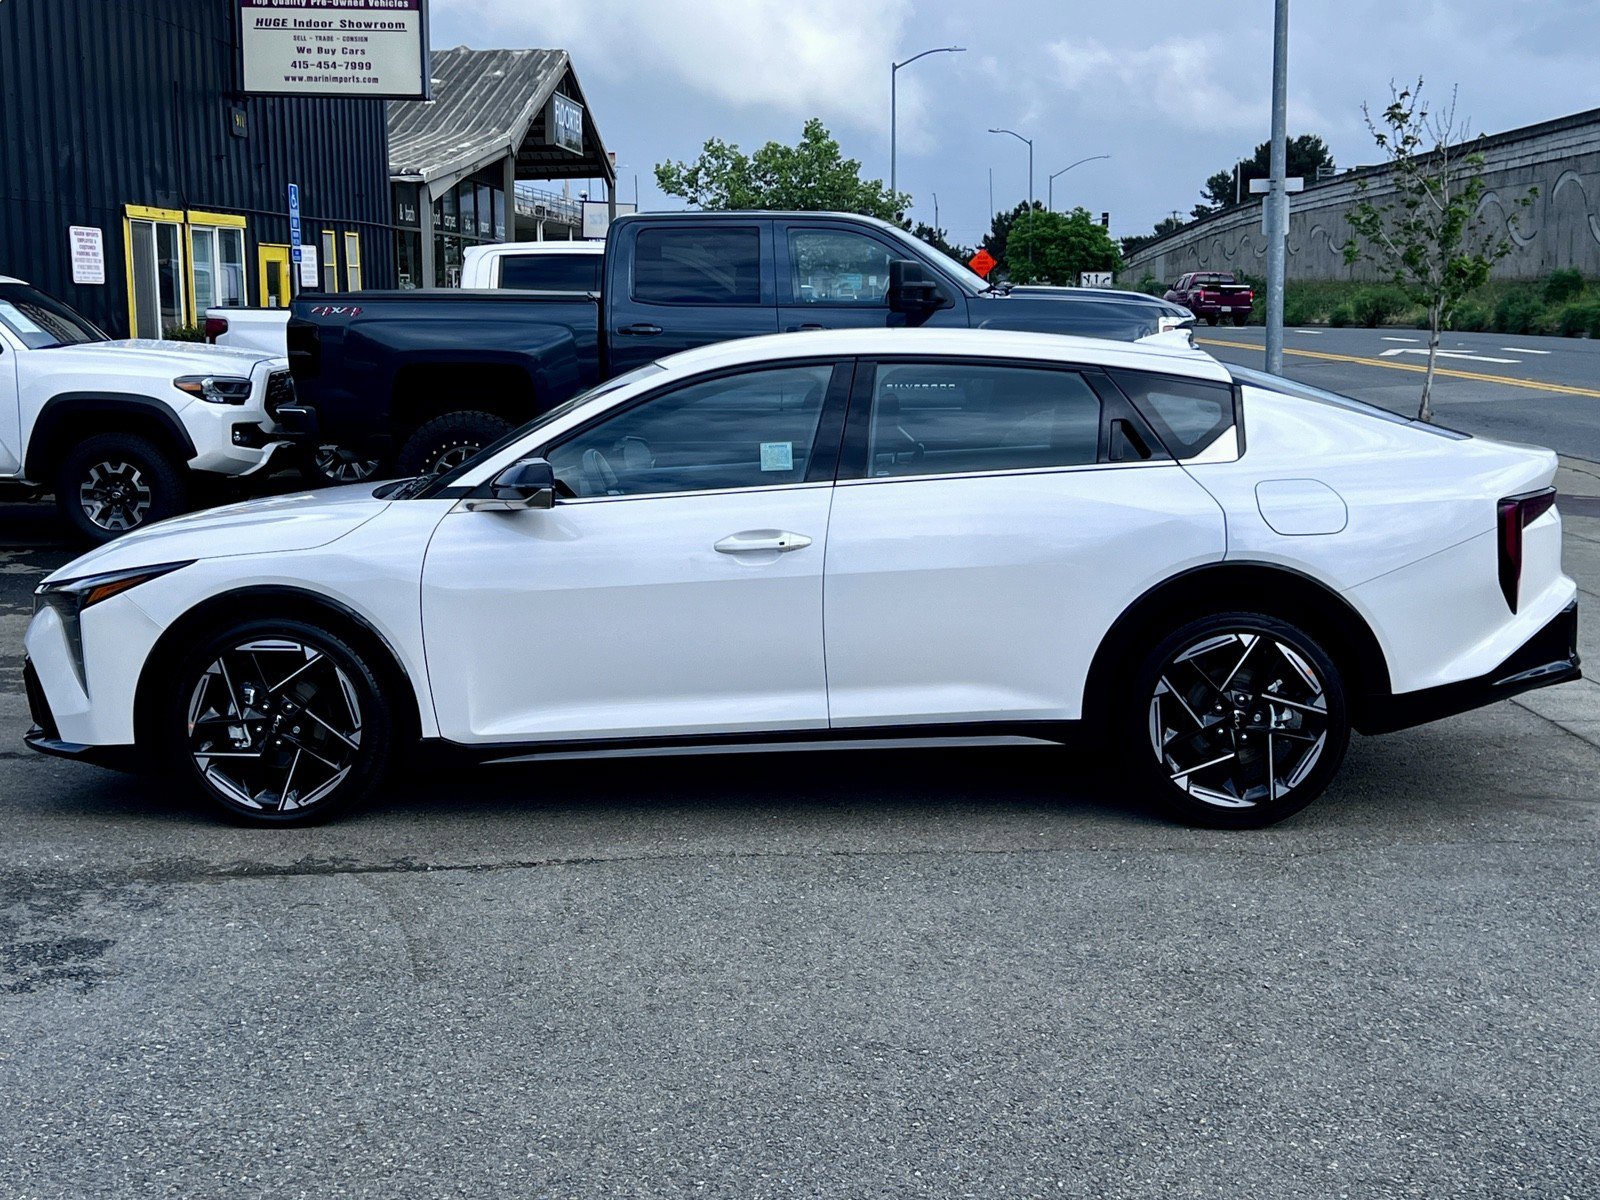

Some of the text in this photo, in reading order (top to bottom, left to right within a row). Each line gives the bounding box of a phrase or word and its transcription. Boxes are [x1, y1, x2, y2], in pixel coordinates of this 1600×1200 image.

[368, 0, 409, 8] Vehicles
[255, 18, 405, 29] HUGE Indoor Showroom
[296, 46, 366, 56] We Buy Cars
[290, 60, 372, 70] 415-454-7999
[284, 75, 379, 84] www.marinimports.com
